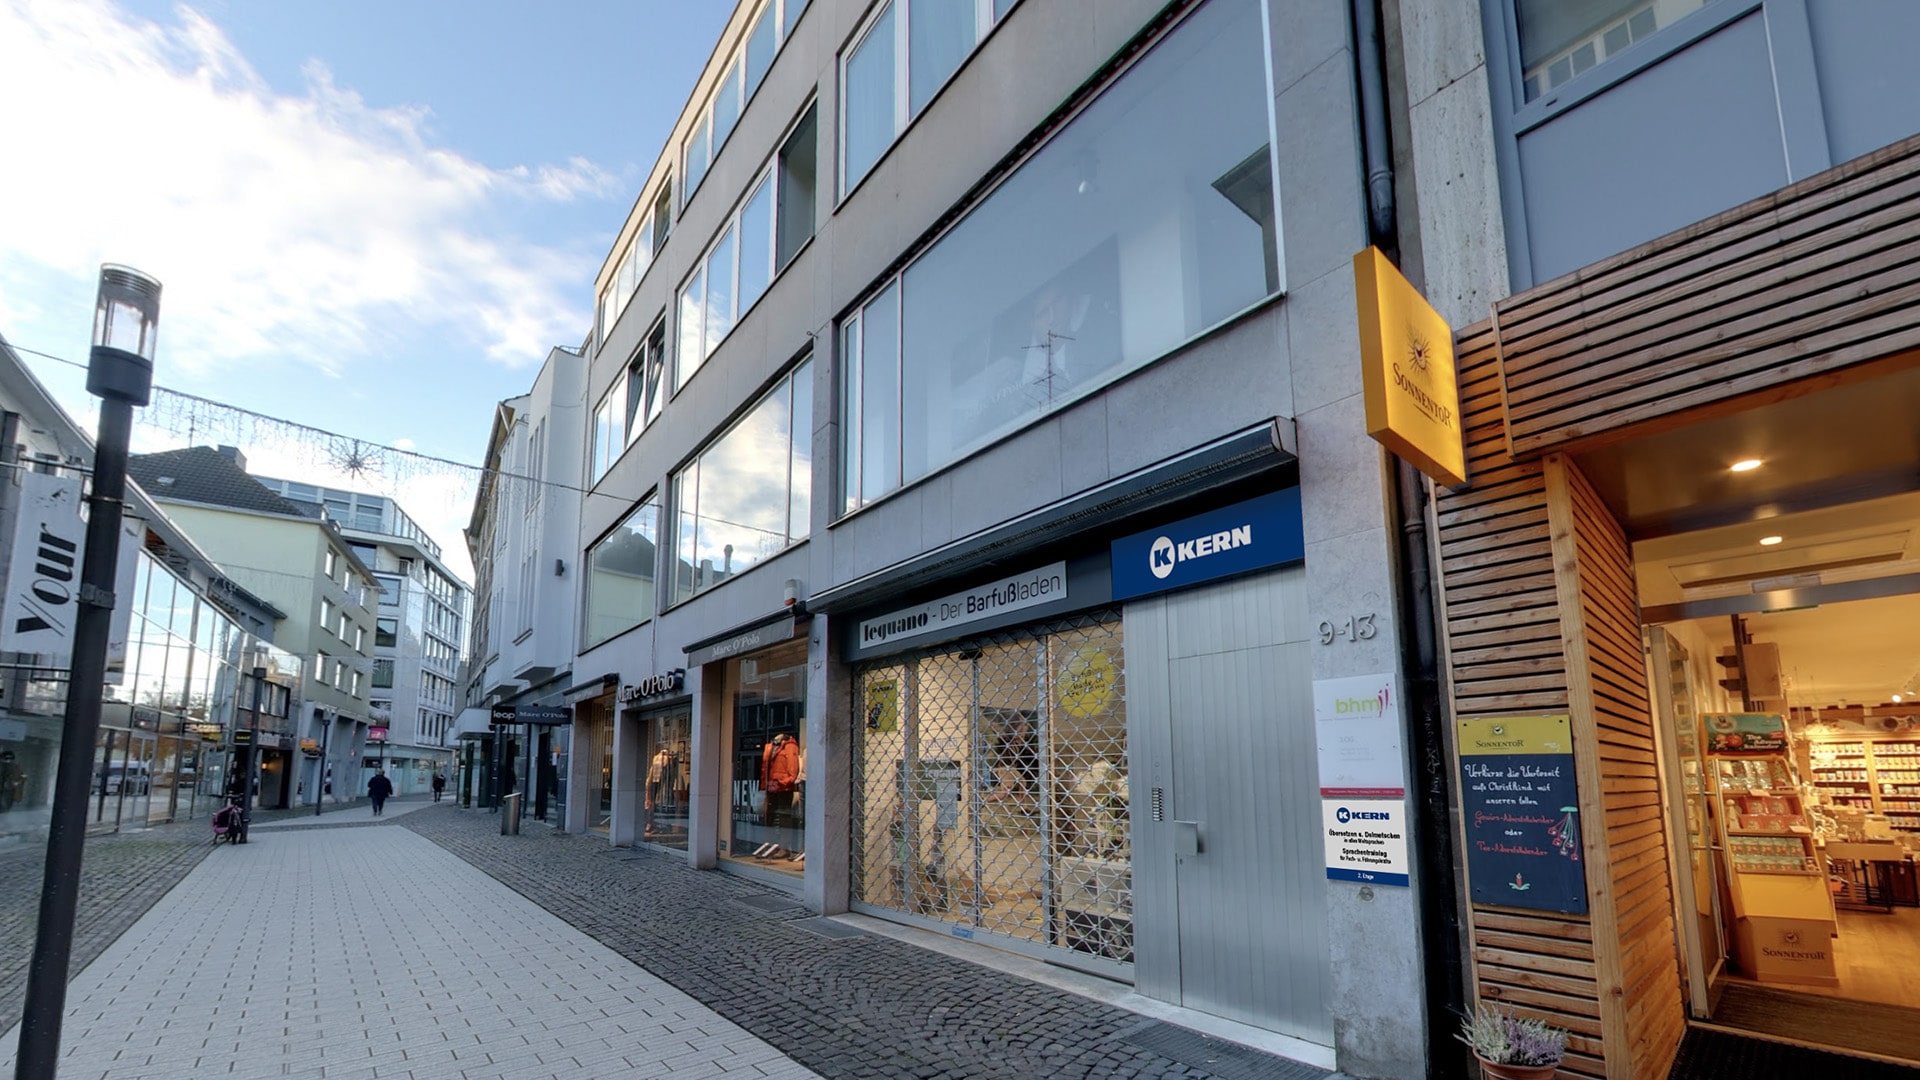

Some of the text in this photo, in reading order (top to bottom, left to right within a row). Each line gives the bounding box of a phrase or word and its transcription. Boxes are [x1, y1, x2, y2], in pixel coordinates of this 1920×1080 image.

[1393, 362, 1452, 429] SONNENTOR
[1177, 524, 1252, 562] KERN
[15, 522, 77, 637] Your
[864, 612, 929, 642] leguano
[940, 602, 963, 622] Der
[966, 575, 1061, 614] Barfußladen
[1319, 612, 1377, 646] 9-13
[711, 645, 732, 657] Marc
[618, 685, 640, 702] Marc
[1475, 739, 1524, 748] SONNENTOR
[1464, 763, 1560, 778] Verkürze die Wartezeit
[1488, 781, 1533, 791] Christkind
[1537, 783, 1551, 791] mit
[733, 779, 760, 808] NEW
[1518, 796, 1538, 805] tollen
[1351, 811, 1390, 820] KERN
[1328, 828, 1357, 837] Übersetzen
[1364, 831, 1401, 839] Dolmetschen
[1342, 848, 1387, 858] Sprachentraining
[1762, 946, 1825, 960] SONNENTOR
